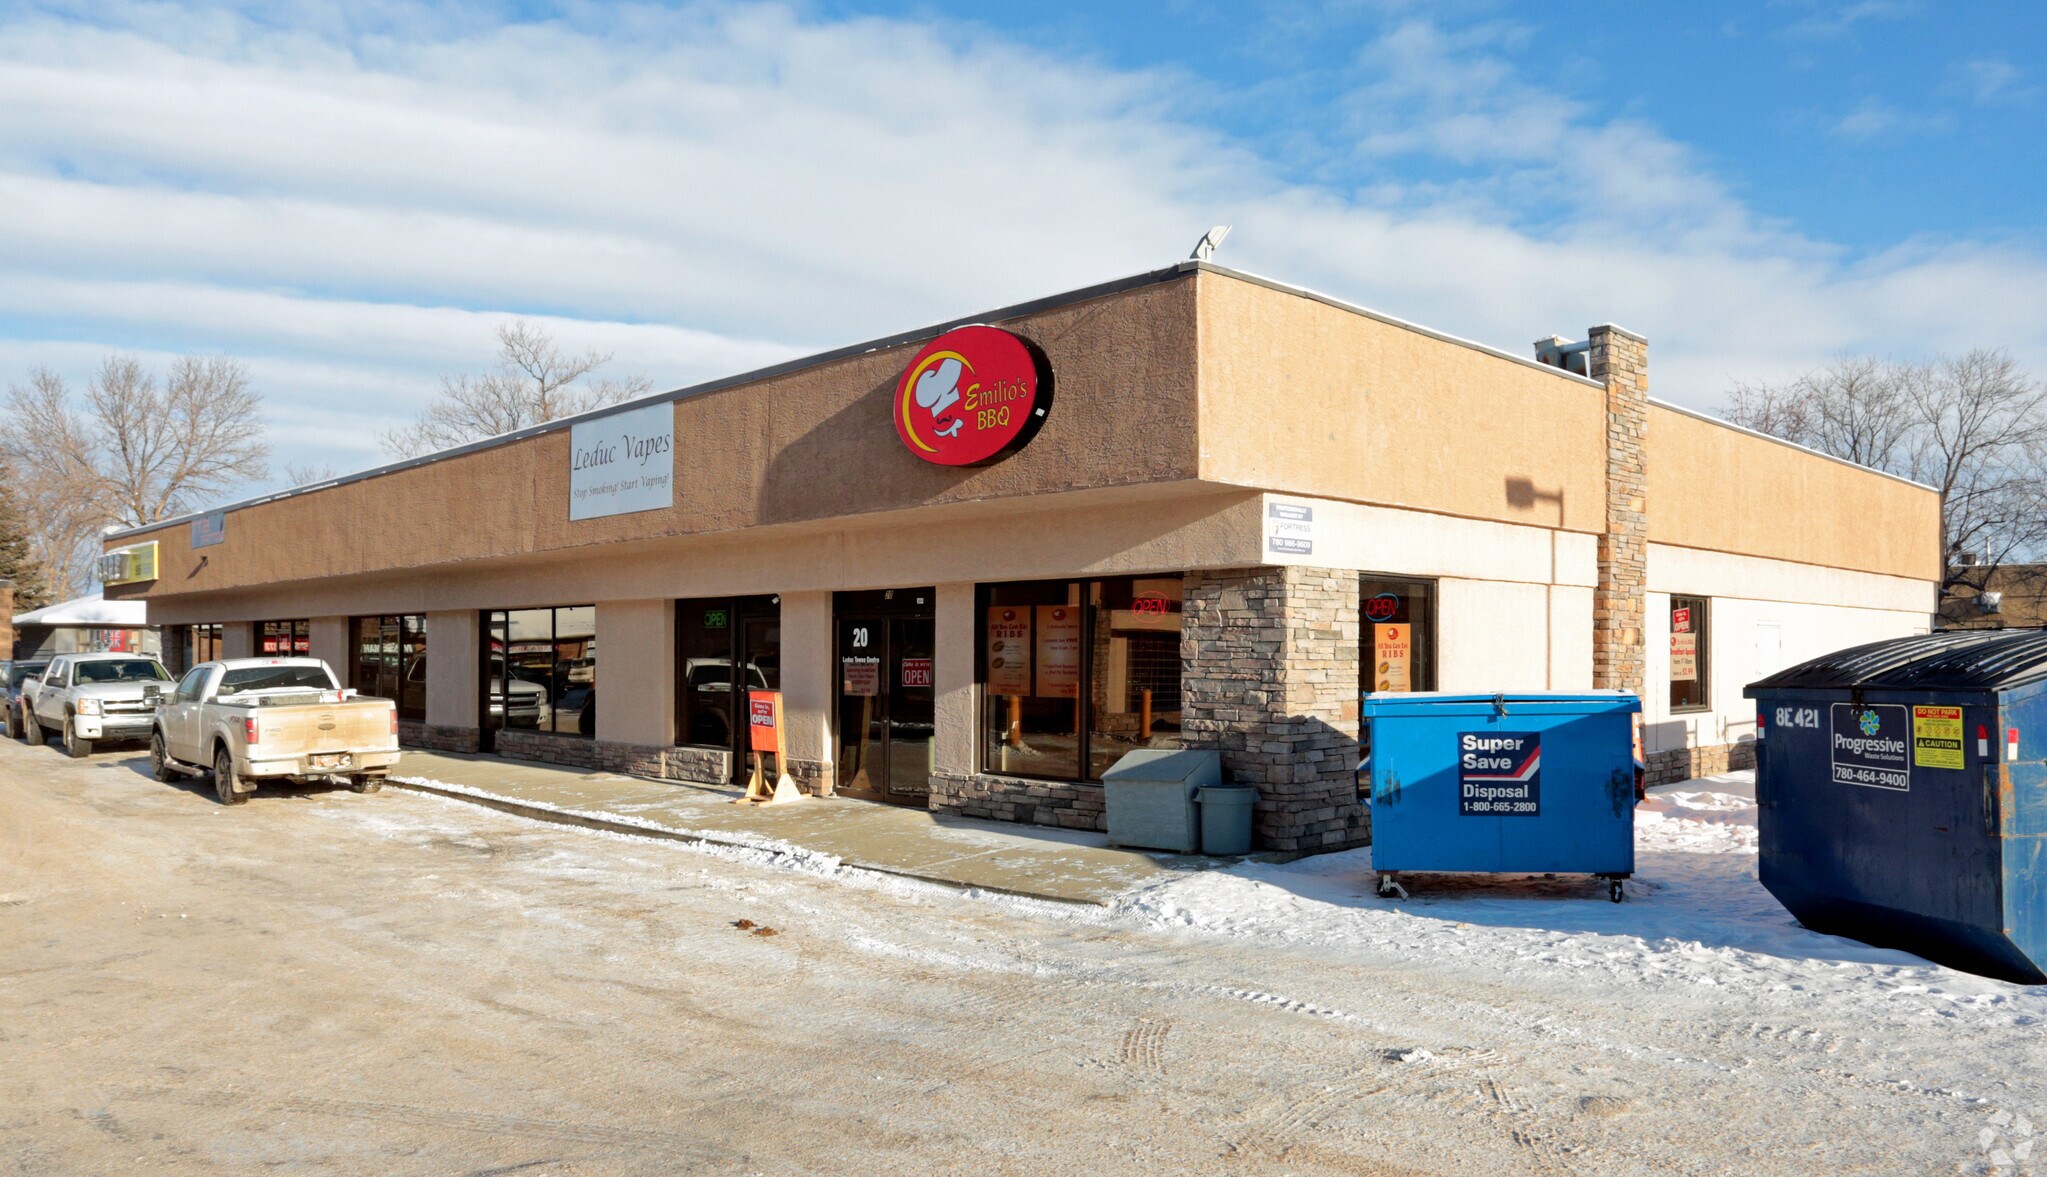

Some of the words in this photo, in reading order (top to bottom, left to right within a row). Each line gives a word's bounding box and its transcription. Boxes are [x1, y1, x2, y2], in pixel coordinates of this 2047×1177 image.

[964, 378, 1027, 411] Emilio's
[977, 406, 1010, 431] BBQ
[573, 440, 617, 471] Leduc
[621, 434, 671, 467] Vapes
[573, 488, 588, 501] Stop
[620, 479, 638, 492] Start
[1280, 522, 1311, 533] FORTRESS
[1134, 598, 1167, 615] OPEN
[1367, 598, 1397, 615] OPEN
[704, 612, 727, 626] OPEN
[852, 627, 868, 648] 20
[996, 630, 1023, 638] RIBS
[1382, 650, 1404, 658] RIBS
[904, 669, 930, 684] OPEN
[752, 713, 773, 725] OPEN
[1462, 734, 1524, 754] Super
[1834, 733, 1905, 755] Progressive
[1925, 741, 1958, 749] CAUTION
[1462, 753, 1512, 769] Save
[1864, 752, 1880, 760] Waste
[1880, 753, 1905, 762] Solutions
[1835, 766, 1907, 787] 780-464-9400
[1463, 783, 1529, 801] Disposal
[1463, 801, 1537, 812] 1-800-665-2800
